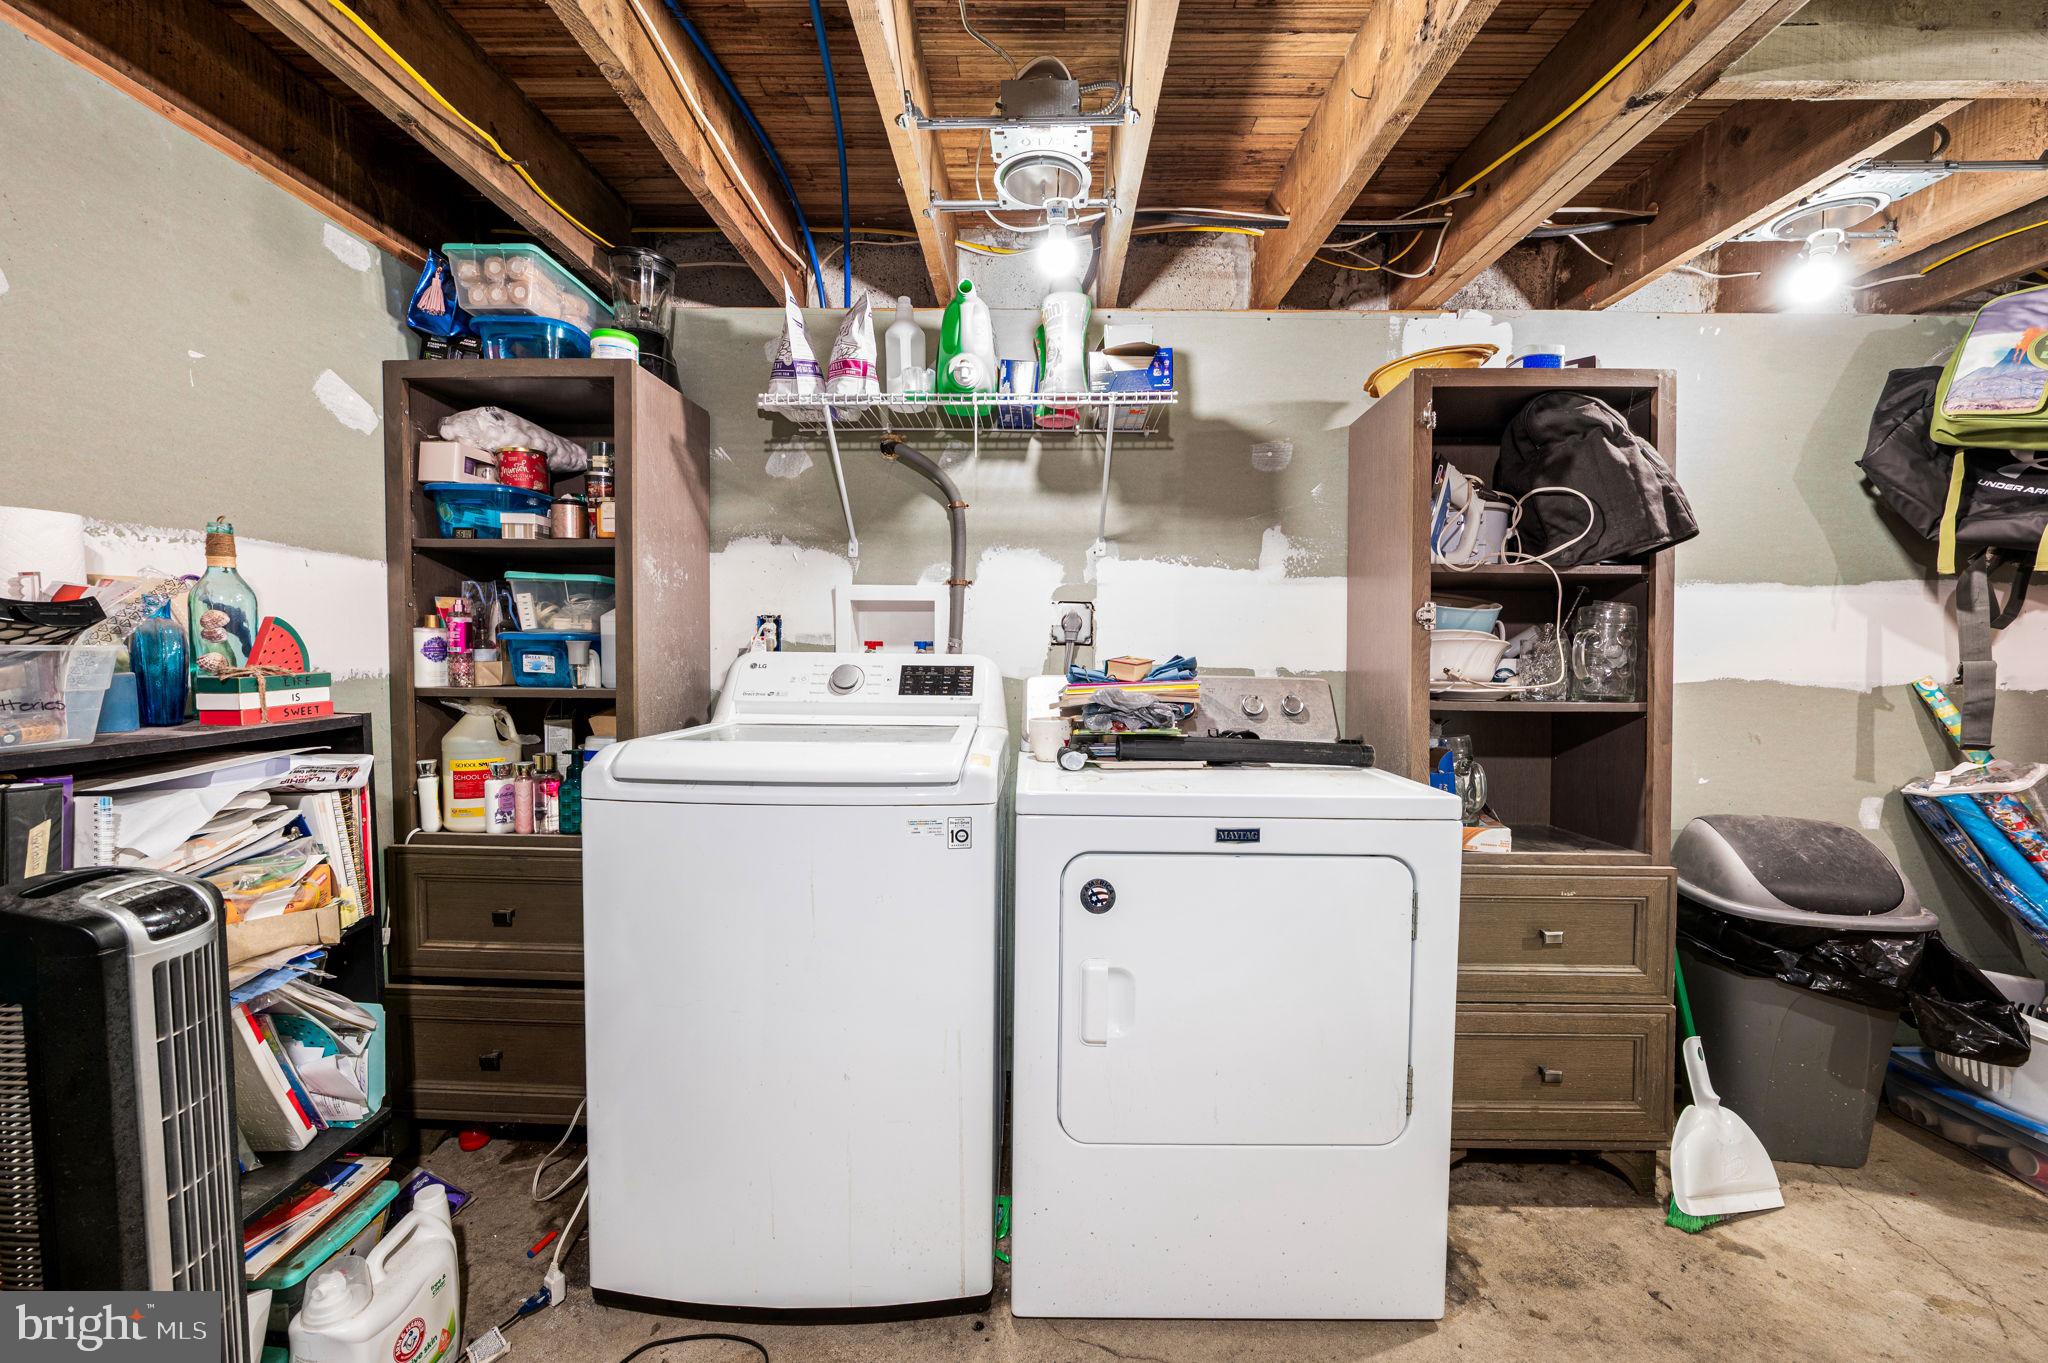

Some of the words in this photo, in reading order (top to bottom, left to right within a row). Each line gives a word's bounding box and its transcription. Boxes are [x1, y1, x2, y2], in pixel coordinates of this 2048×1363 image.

[1977, 478, 2024, 492] UNDER
[283, 675, 311, 687] LIFE
[291, 692, 301, 702] IS
[283, 705, 319, 717] SWEET
[950, 829, 969, 843] 10
[1218, 831, 1258, 840] MAYTAG
